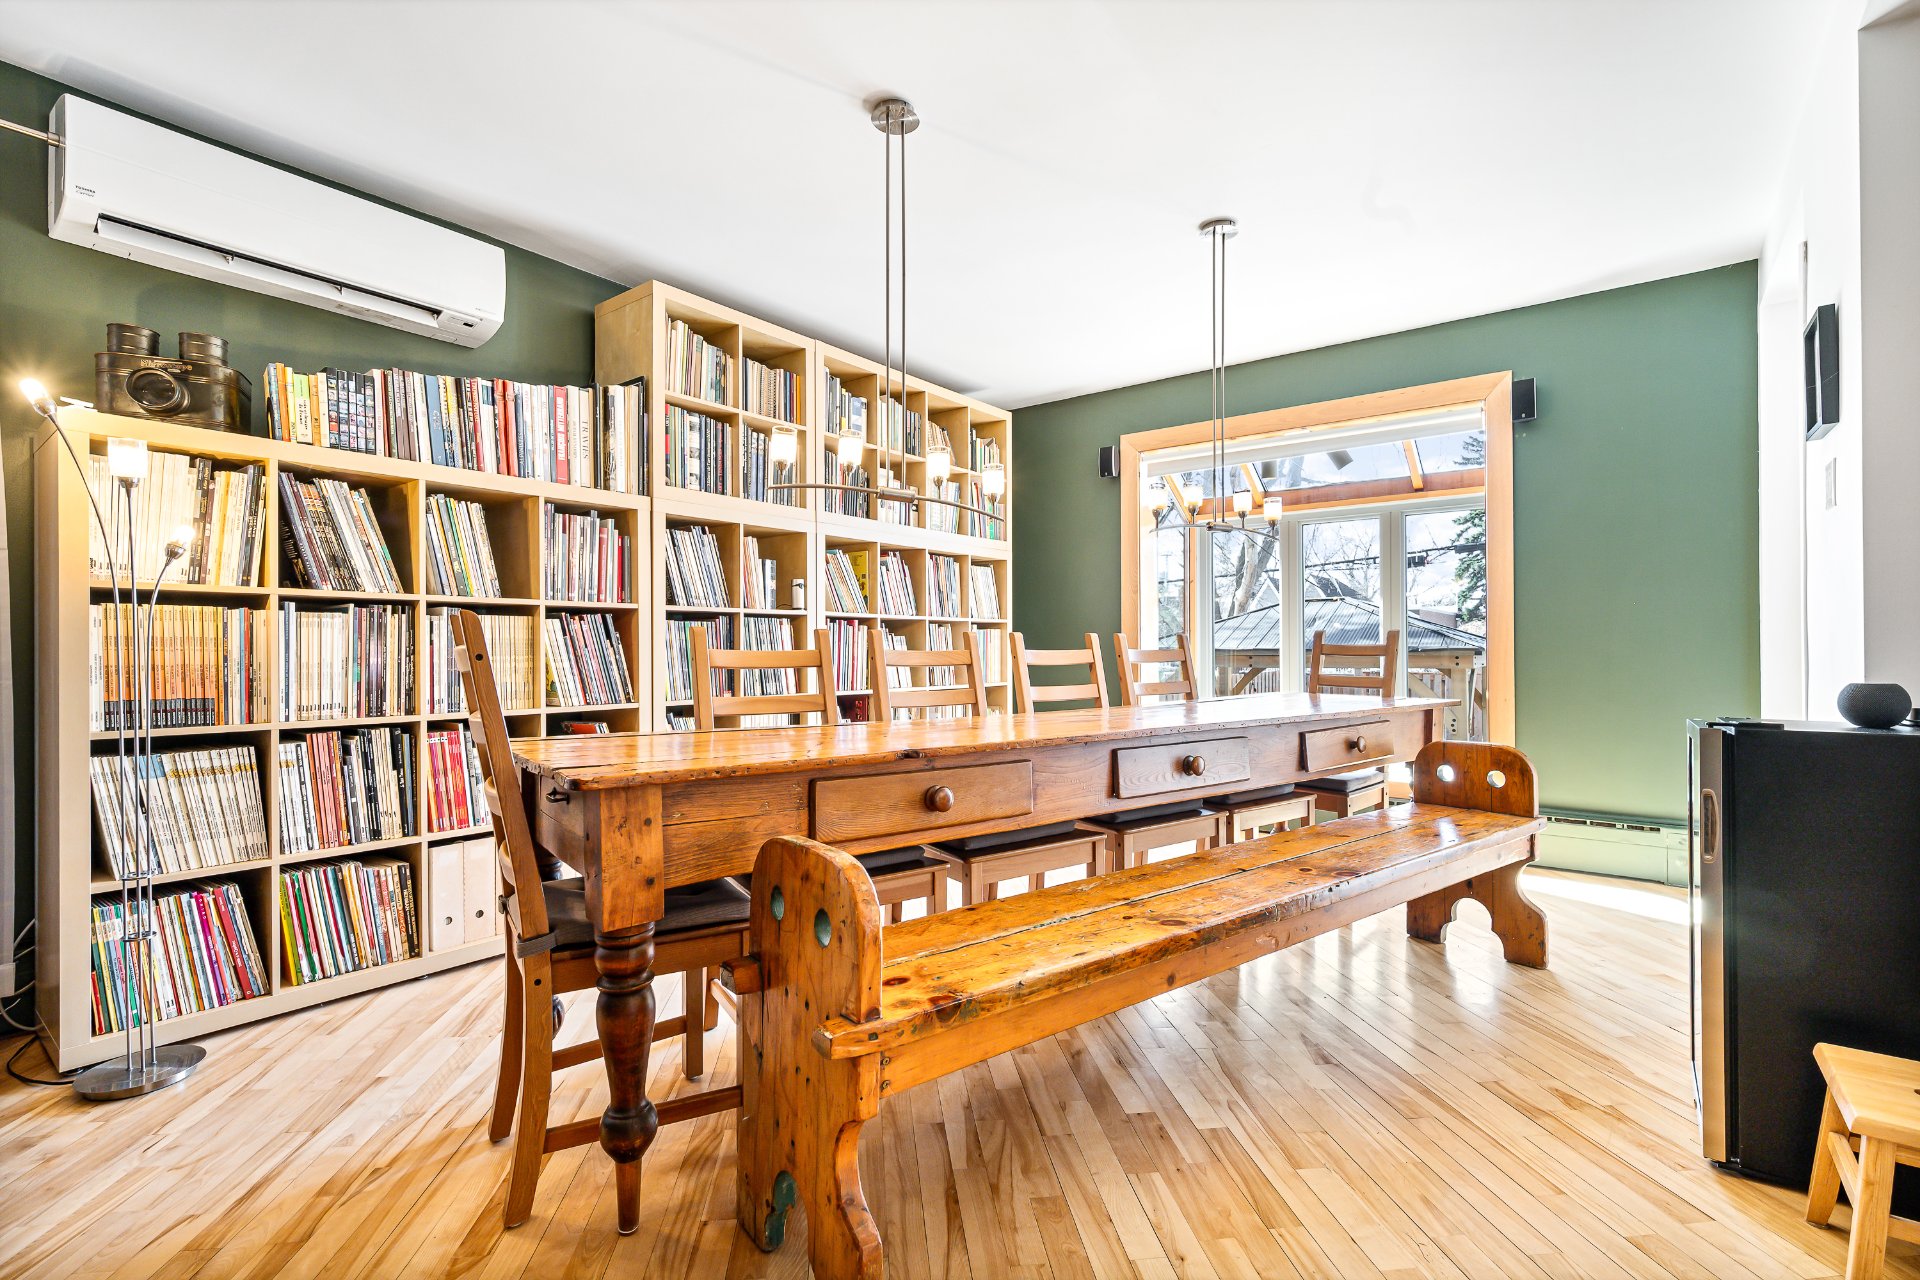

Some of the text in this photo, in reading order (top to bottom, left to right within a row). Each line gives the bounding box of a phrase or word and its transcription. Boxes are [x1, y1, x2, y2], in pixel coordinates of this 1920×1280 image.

[75, 184, 96, 194] TOSHIBA
[556, 396, 566, 461] FRANÇOIS MITTERRAND
